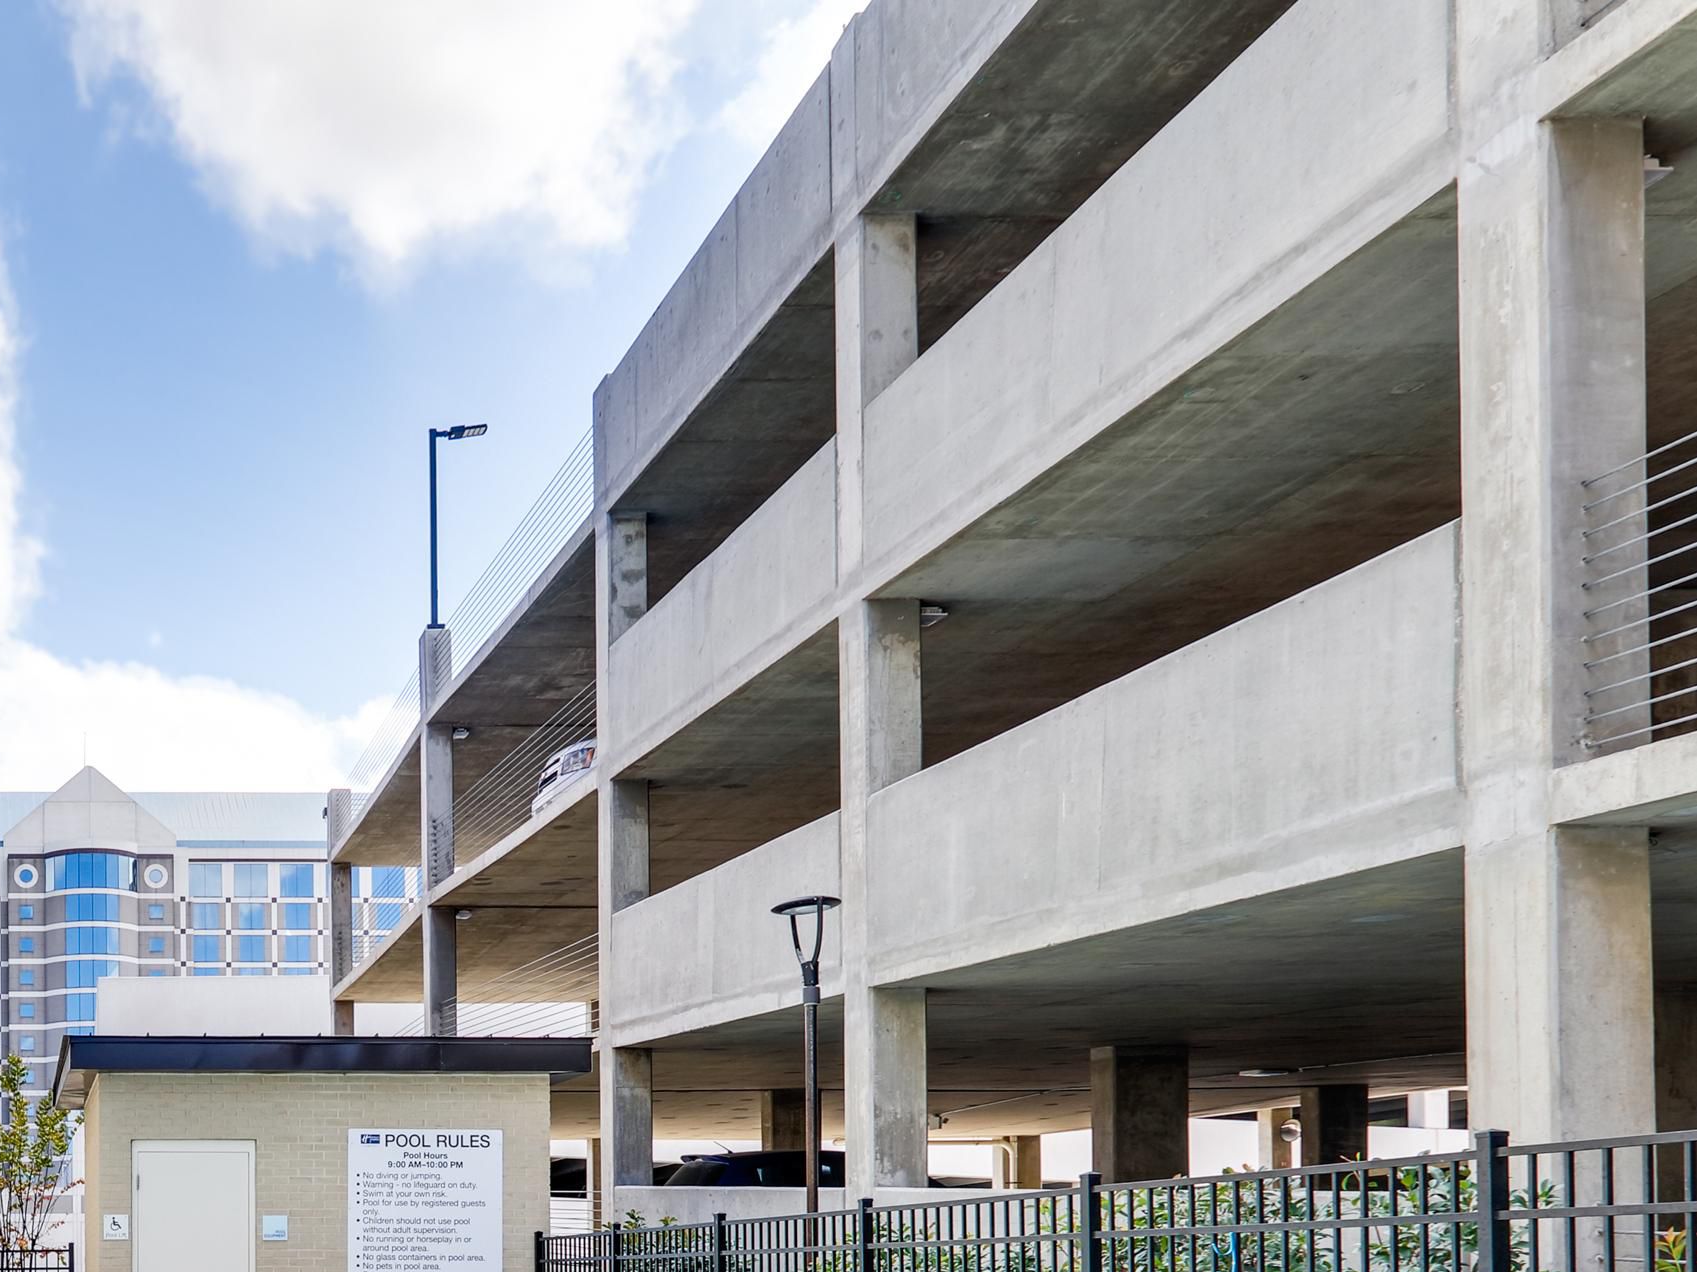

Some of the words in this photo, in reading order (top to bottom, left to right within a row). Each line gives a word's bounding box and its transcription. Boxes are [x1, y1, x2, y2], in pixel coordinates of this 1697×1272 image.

[385, 1134, 430, 1147] POOL
[437, 1135, 490, 1148] RULES
[422, 1200, 458, 1208] registered
[454, 1218, 470, 1226] pool
[414, 1227, 457, 1235] supervision.
[376, 1236, 404, 1244] running
[417, 1236, 452, 1244] horseplay
[376, 1254, 396, 1262] glass
[448, 1254, 464, 1262] pool
[376, 1263, 392, 1271] pets
[404, 1263, 420, 1271] pool
